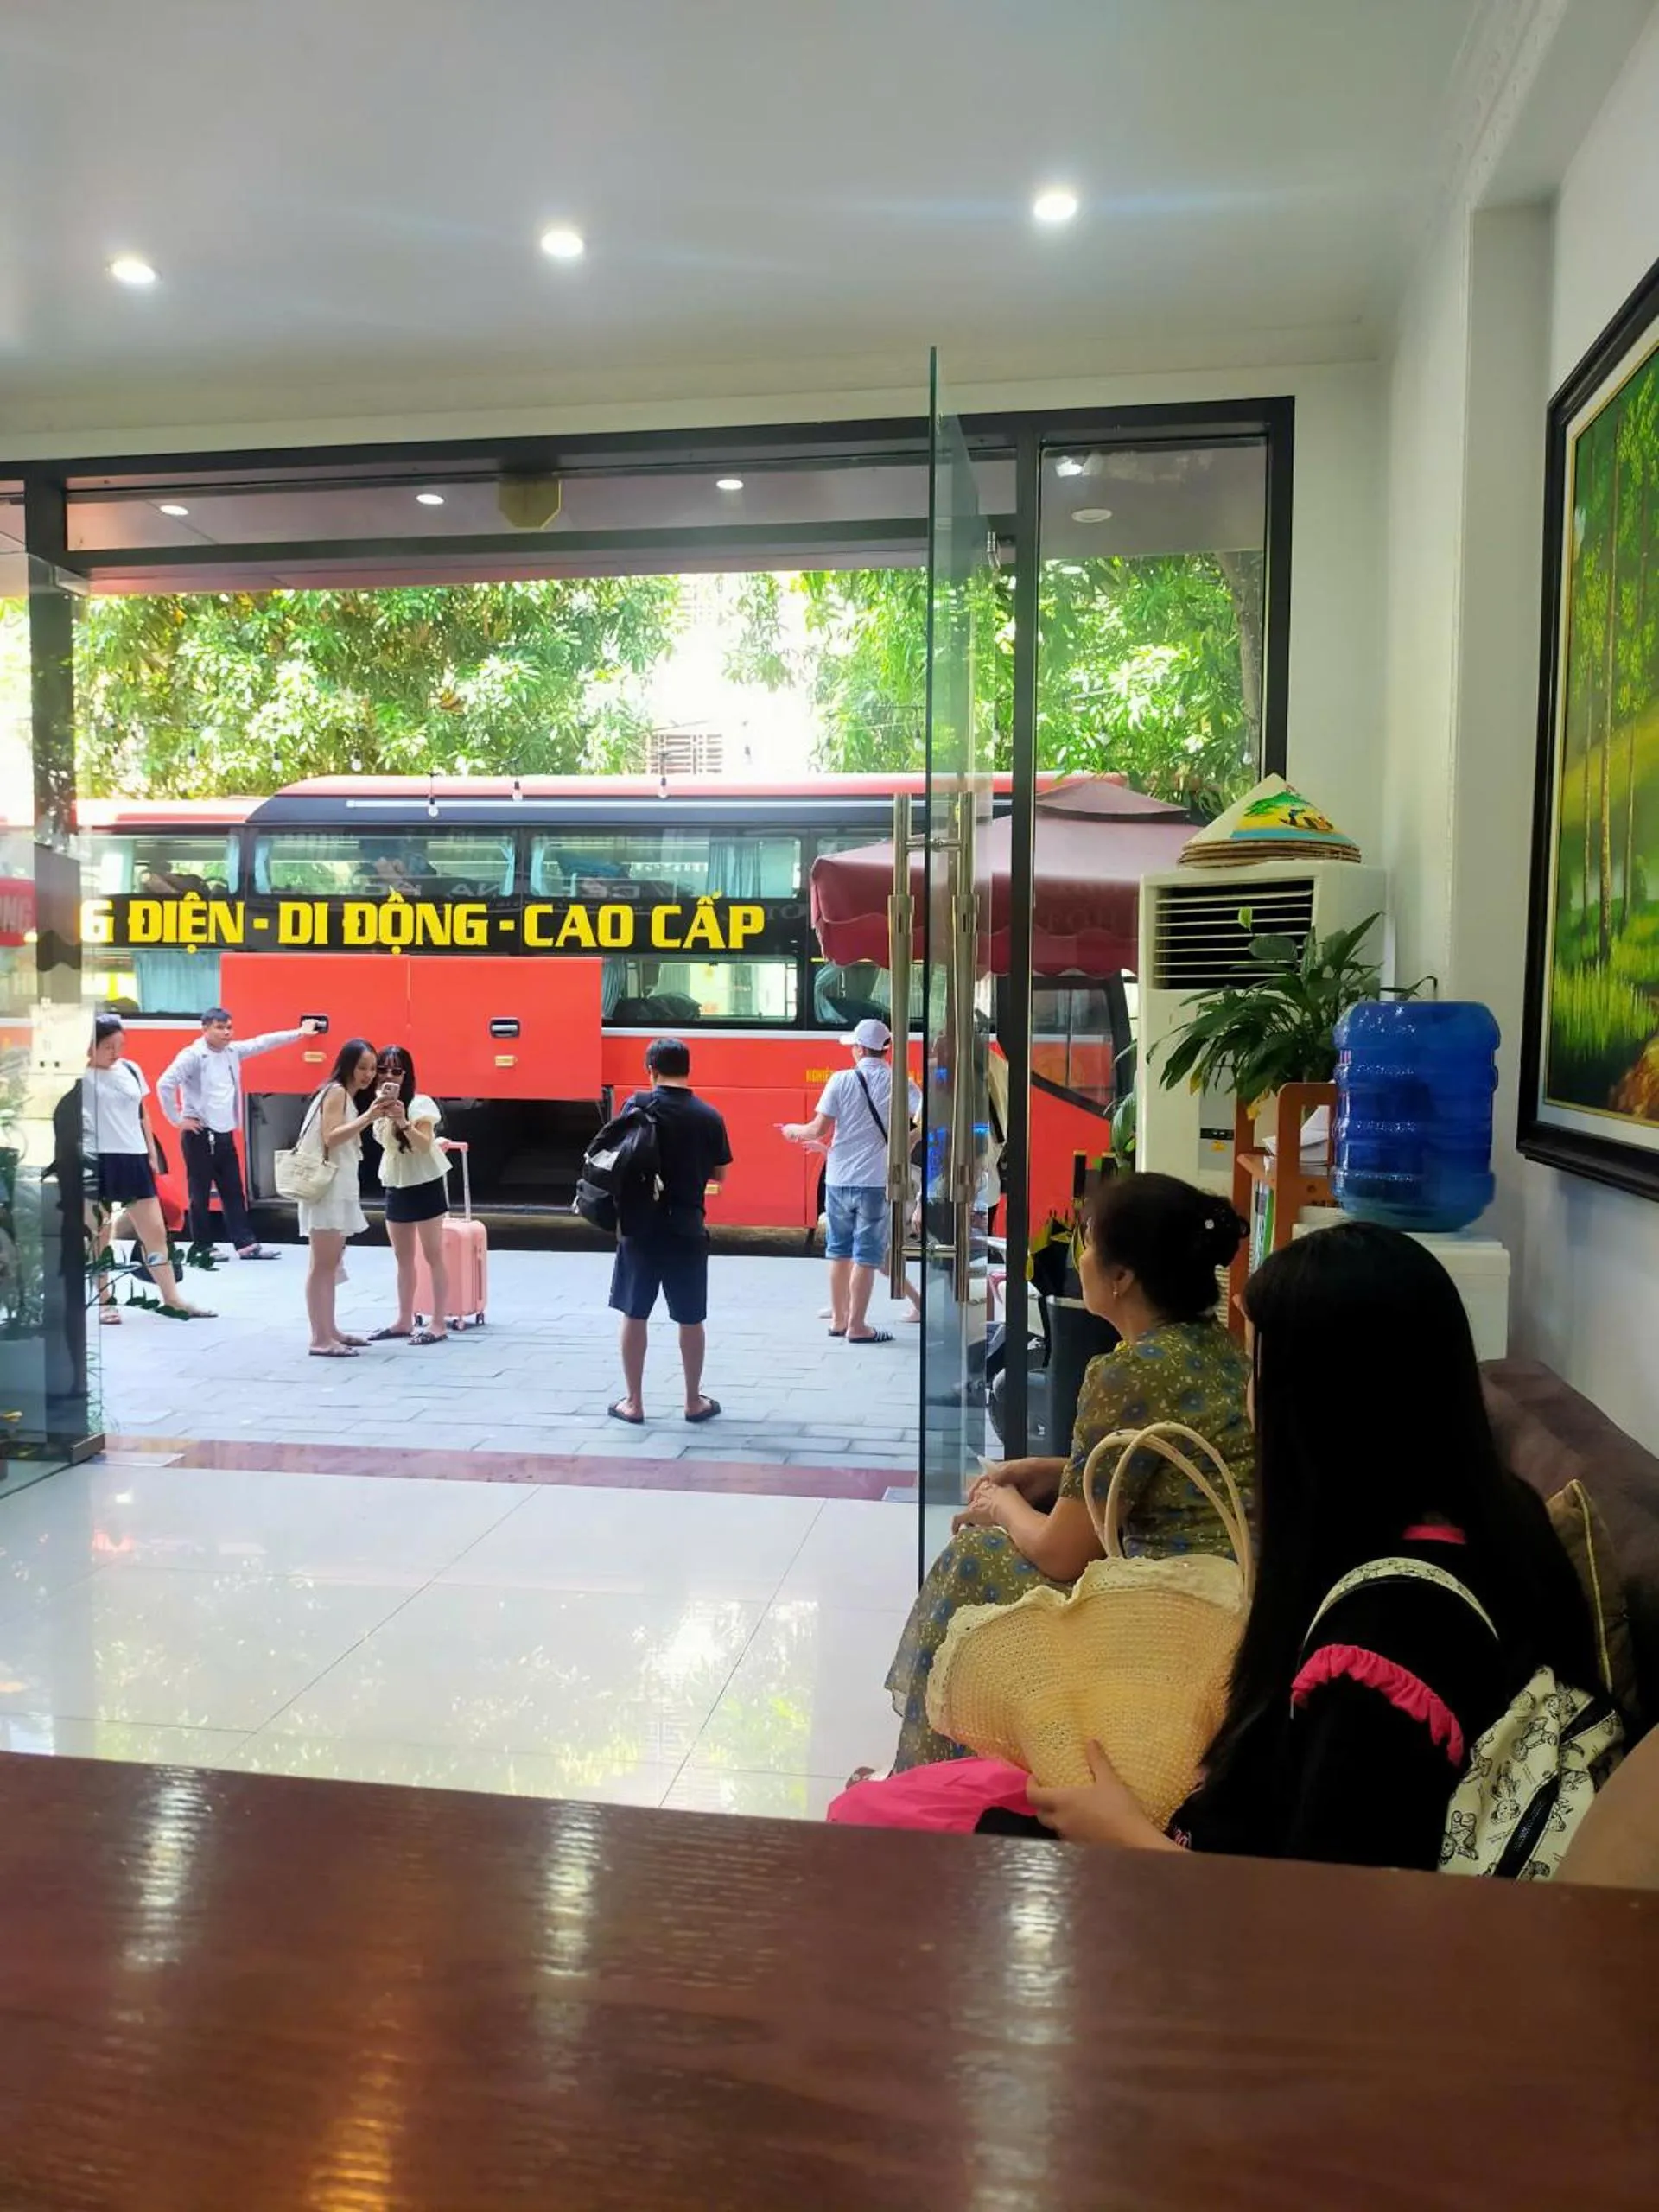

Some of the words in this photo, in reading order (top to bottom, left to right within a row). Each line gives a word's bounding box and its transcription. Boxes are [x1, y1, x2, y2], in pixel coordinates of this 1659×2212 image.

[128, 890, 245, 953] ĐIỆN
[277, 901, 329, 944] DI
[341, 889, 489, 956] ĐỘNG
[524, 904, 634, 948] CAO
[651, 888, 765, 949] CẤP
